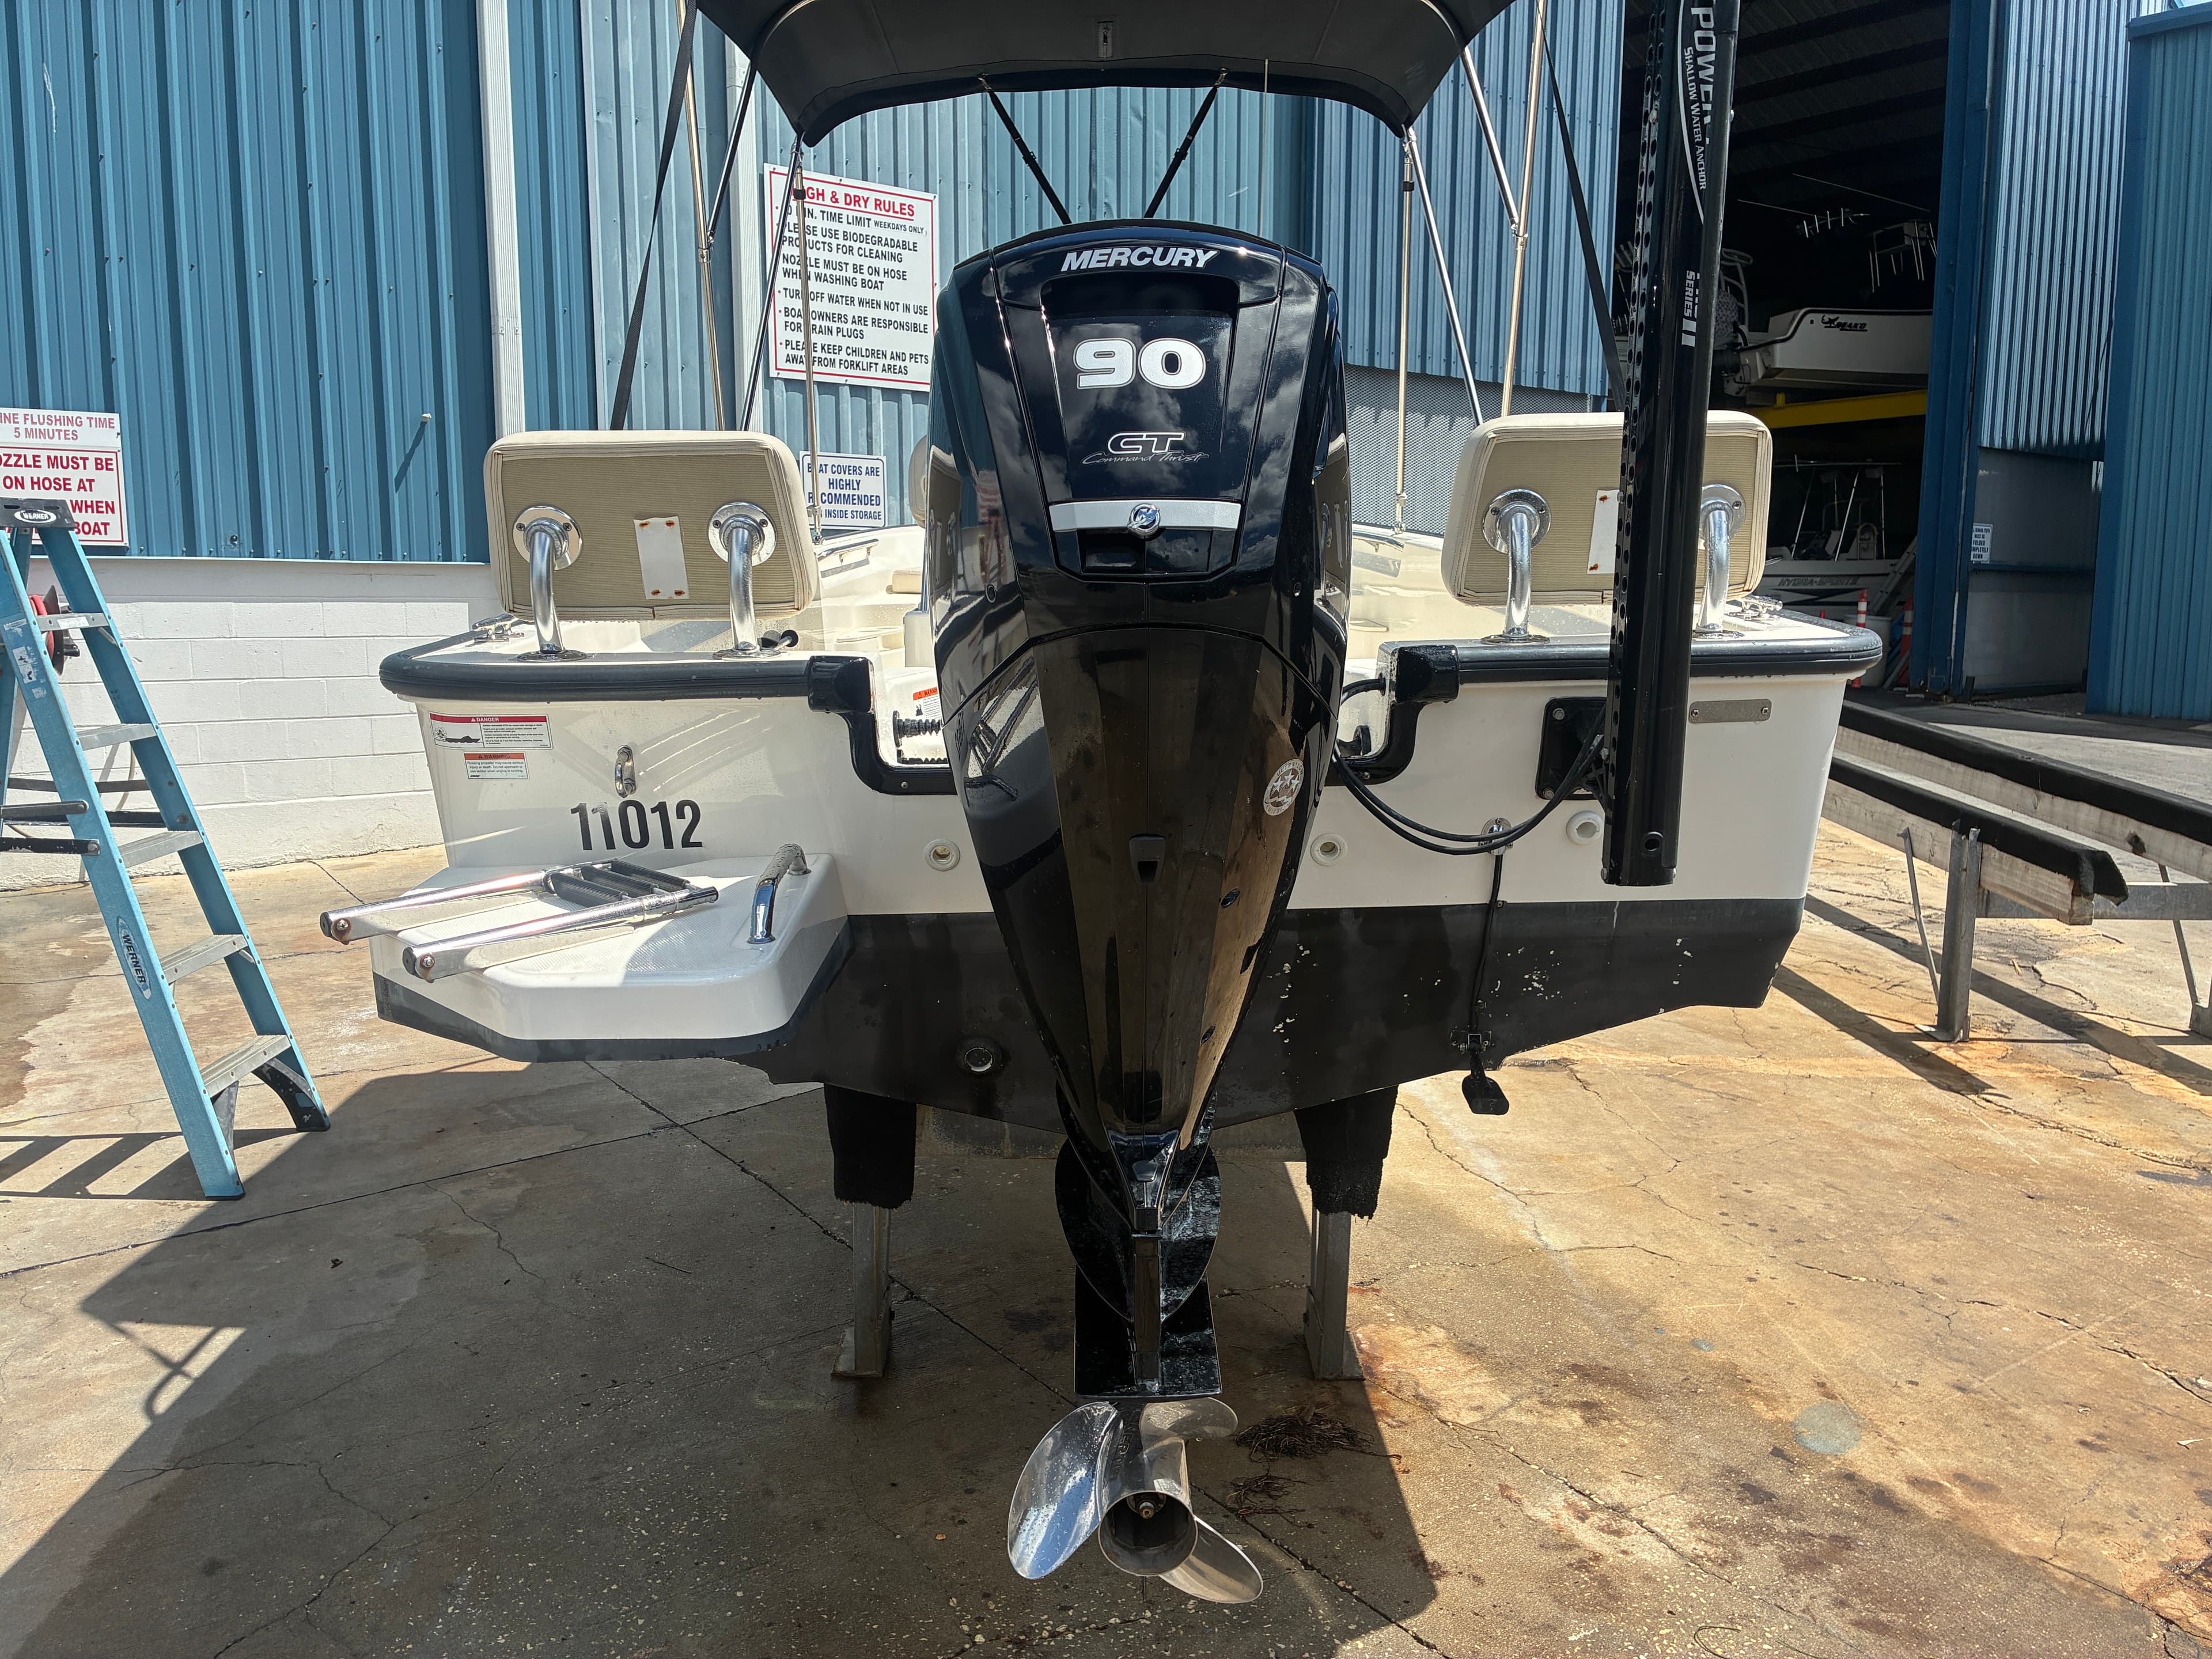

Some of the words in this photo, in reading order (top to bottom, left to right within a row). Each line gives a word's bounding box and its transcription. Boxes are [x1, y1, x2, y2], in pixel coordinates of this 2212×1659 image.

[1684, 46, 1698, 100] SHALLOW
[1691, 102, 1702, 142] WATER
[1695, 145, 1706, 190] ANCHOR
[830, 191, 839, 204] &
[844, 193, 870, 209] DRY
[874, 198, 915, 217] RULES
[820, 210, 843, 224] TIME
[847, 214, 871, 228] LIMIT
[874, 219, 907, 232] WEEKDAYS
[909, 225, 924, 234] ONLY
[785, 221, 817, 236] LESE
[821, 227, 839, 240] USE
[843, 230, 918, 252] BIODEGRADABLE
[783, 236, 833, 252] PROUCTS
[836, 243, 854, 256] FOR
[857, 247, 903, 263] CLEANING
[1060, 247, 1219, 272] MERCURY
[783, 253, 820, 268] NOZLE
[824, 259, 849, 272] MUST
[853, 263, 864, 274] BE
[868, 266, 880, 276] ON
[883, 268, 907, 281] HOSE
[814, 272, 858, 287] WASHING
[861, 278, 884, 291] BOAT
[1684, 270, 1695, 317] SERIES
[783, 287, 802, 300] TUR
[810, 291, 825, 302] OFF
[828, 293, 855, 306] WATER
[858, 297, 881, 310] WHEN
[884, 301, 900, 312] NOT
[903, 302, 910, 313] IN
[913, 304, 928, 316] USE
[784, 306, 803, 319] BOA
[811, 310, 848, 324] OWNERS
[851, 315, 868, 327] ARE
[872, 317, 928, 334] RESPONSIBLE
[785, 321, 802, 332] FOR
[811, 324, 833, 336] RAIN
[836, 327, 864, 339] PLUGS
[785, 339, 817, 353] PLEAE
[821, 343, 843, 355] KEEP
[846, 346, 887, 360] CHILDREN
[890, 351, 906, 362] AND
[909, 353, 929, 364] PETS
[785, 353, 806, 365] AWA
[813, 356, 836, 368] FROM
[839, 358, 878, 372] FORKLIFT
[881, 363, 908, 375] AREAS
[1073, 338, 1206, 389] 90
[24, 413, 83, 427] FLUSHING
[86, 416, 115, 429] TIME
[14, 427, 21, 438] 5
[25, 428, 78, 441] MINUTES
[0, 453, 41, 468] ZZLE
[47, 455, 89, 470] MUST
[94, 457, 114, 471] BE
[808, 463, 828, 474] BAT
[831, 464, 862, 476] COVERS
[865, 466, 880, 477] ARE
[1081, 452, 1152, 464] Command
[3, 475, 25, 490] ON
[31, 476, 72, 491] HOSE
[77, 478, 95, 492] AT
[828, 478, 861, 491] HIGHLY
[70, 499, 115, 514] WHEN
[808, 491, 881, 506] RCOMMENDED
[825, 509, 849, 519] INSIDE
[850, 510, 881, 520] STORAGE
[570, 800, 703, 851] 11012
[123, 934, 146, 983] WERNER
